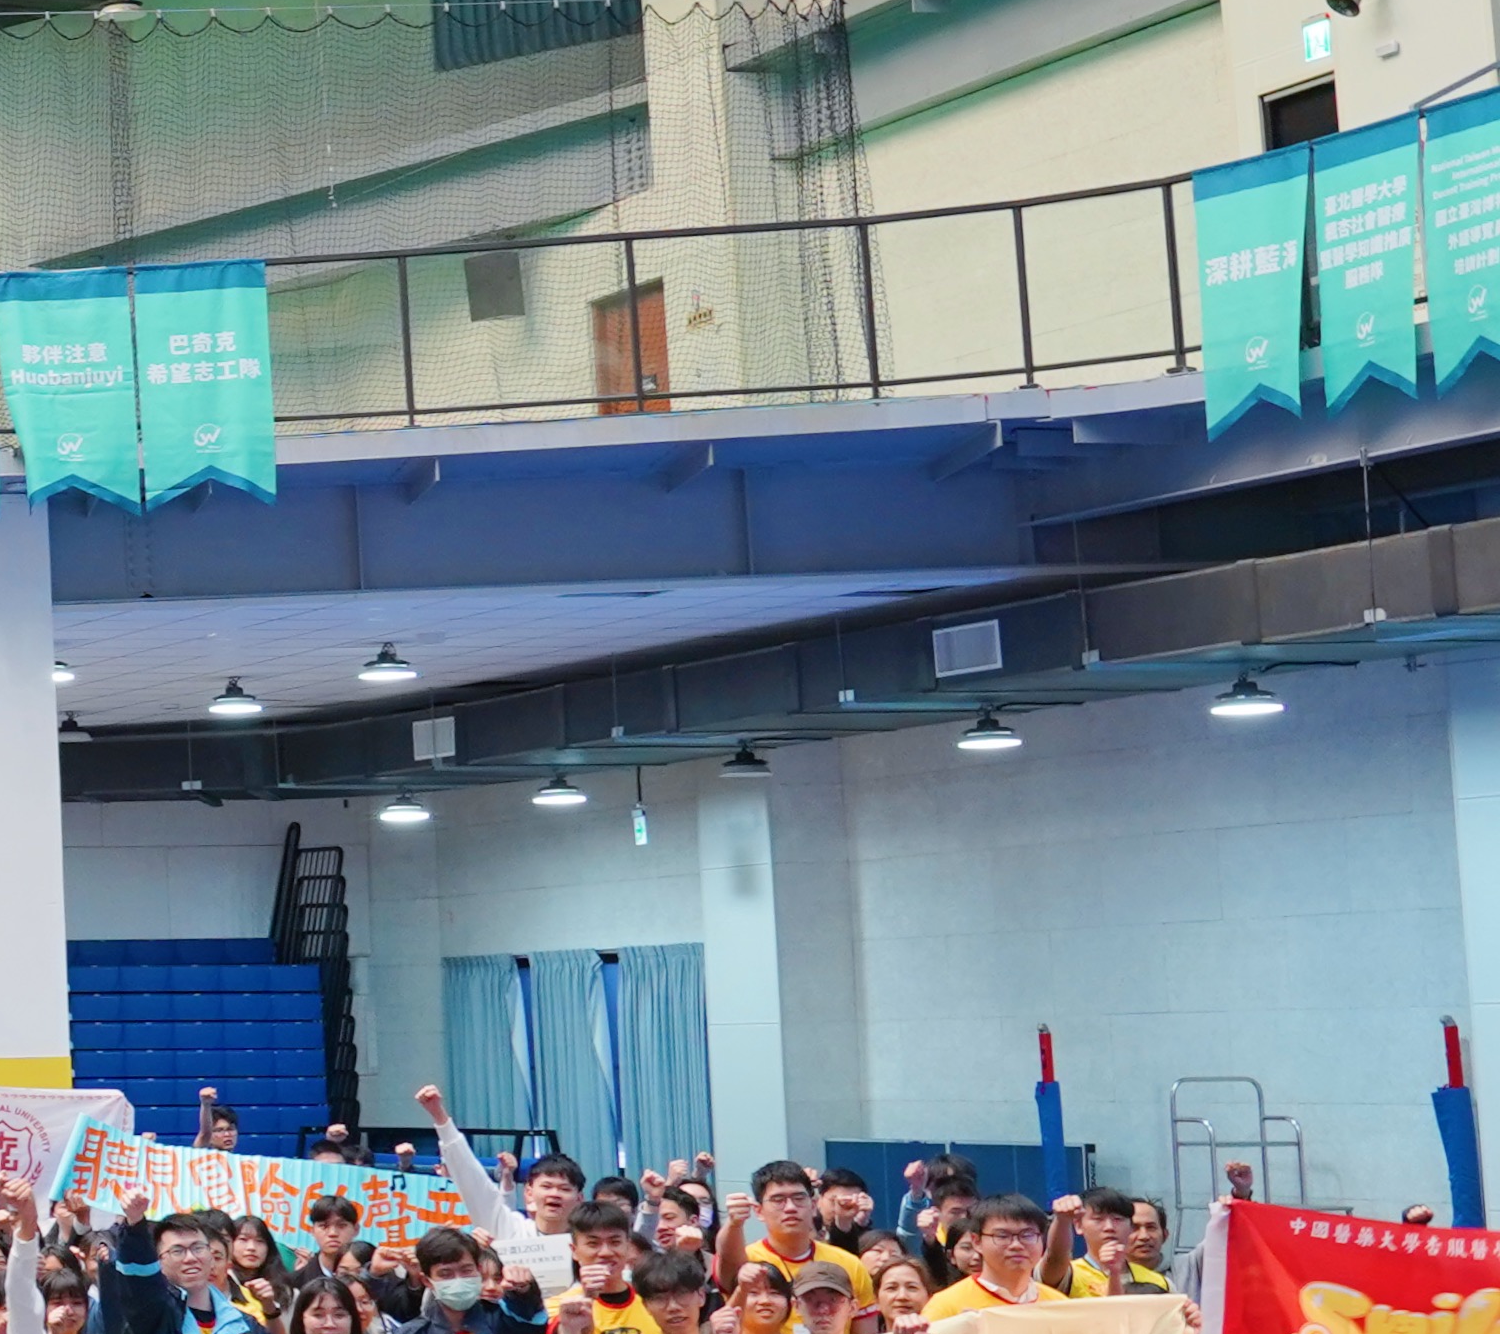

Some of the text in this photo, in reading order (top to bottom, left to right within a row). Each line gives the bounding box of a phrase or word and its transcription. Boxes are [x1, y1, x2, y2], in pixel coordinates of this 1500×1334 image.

[22, 342, 108, 365] 夥伴注意
[168, 329, 237, 355] 巴奇克
[146, 357, 262, 387] 希望志工隊
